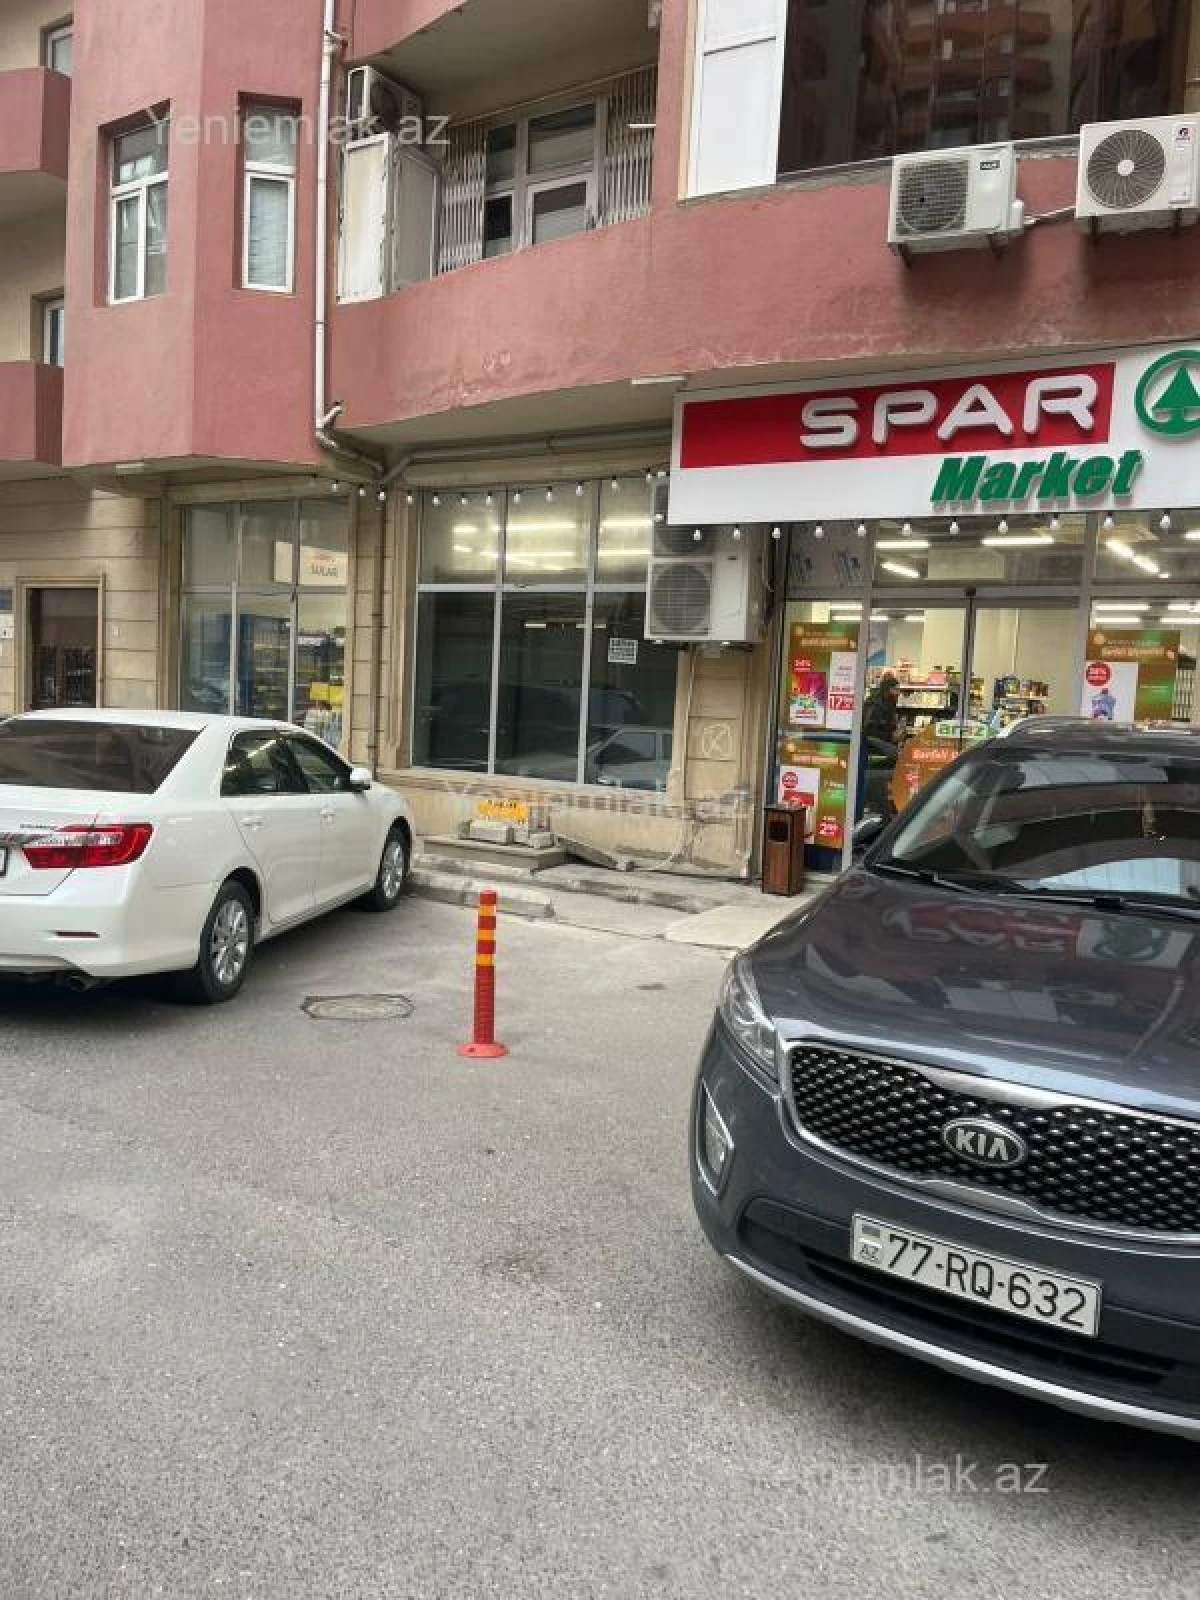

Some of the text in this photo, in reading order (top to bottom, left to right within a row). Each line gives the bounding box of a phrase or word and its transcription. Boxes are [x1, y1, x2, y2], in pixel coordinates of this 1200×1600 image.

[799, 373, 1098, 449] SPAR
[930, 449, 1143, 505] Market
[955, 1127, 1009, 1161] KIA
[889, 1233, 1086, 1328] 77-RQ-632
